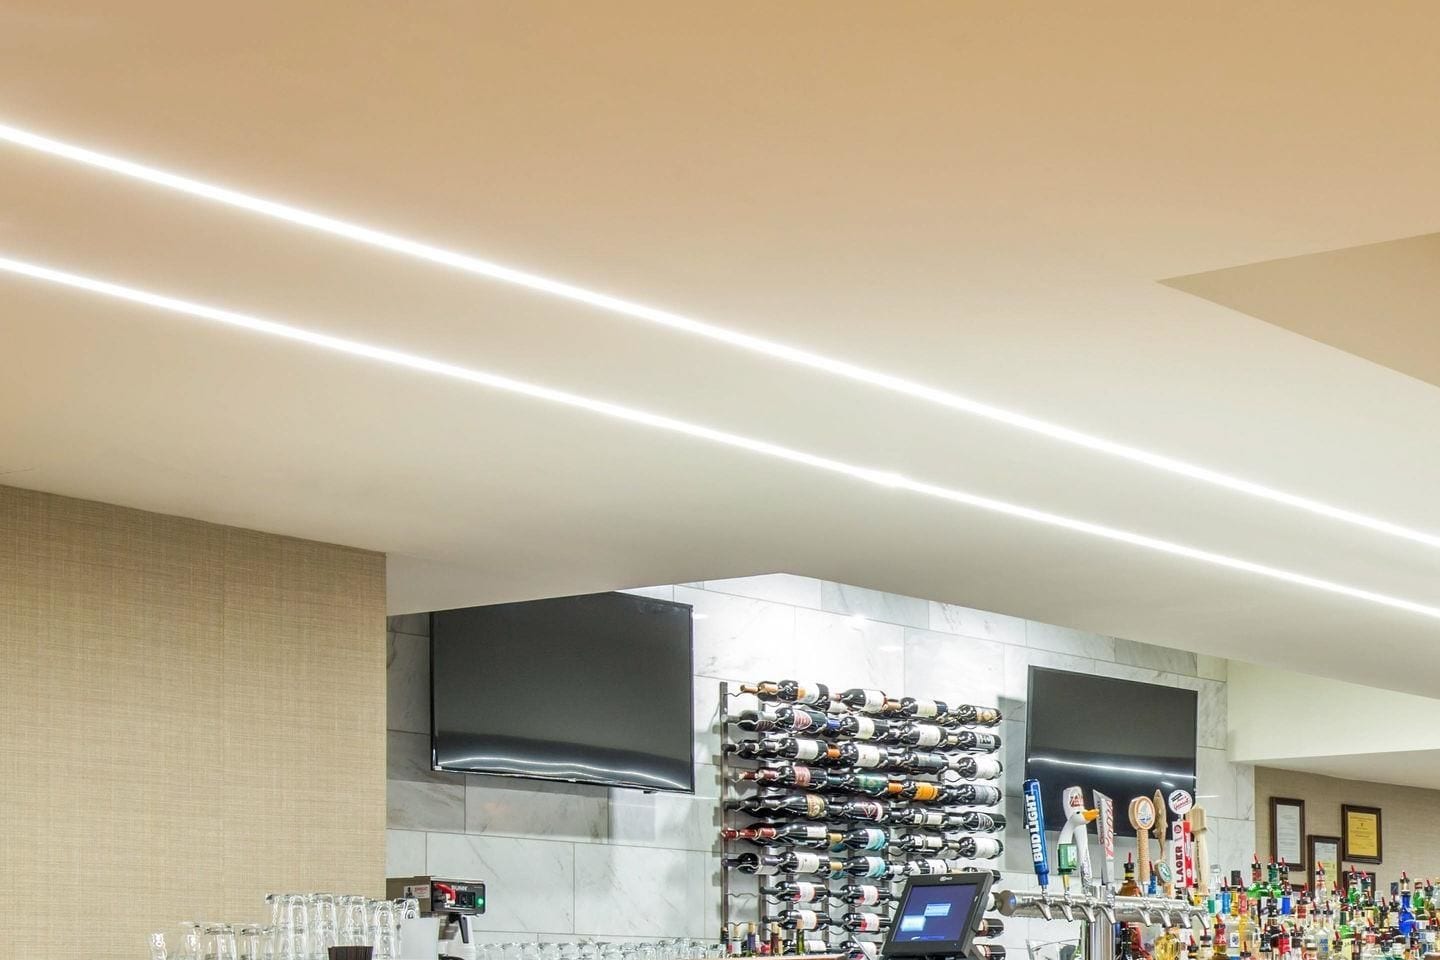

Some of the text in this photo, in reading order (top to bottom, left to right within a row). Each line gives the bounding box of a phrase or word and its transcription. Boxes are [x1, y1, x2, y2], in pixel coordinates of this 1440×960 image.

[1026, 794, 1043, 863] BUD LIGHT
[1175, 846, 1184, 883] LAGER
